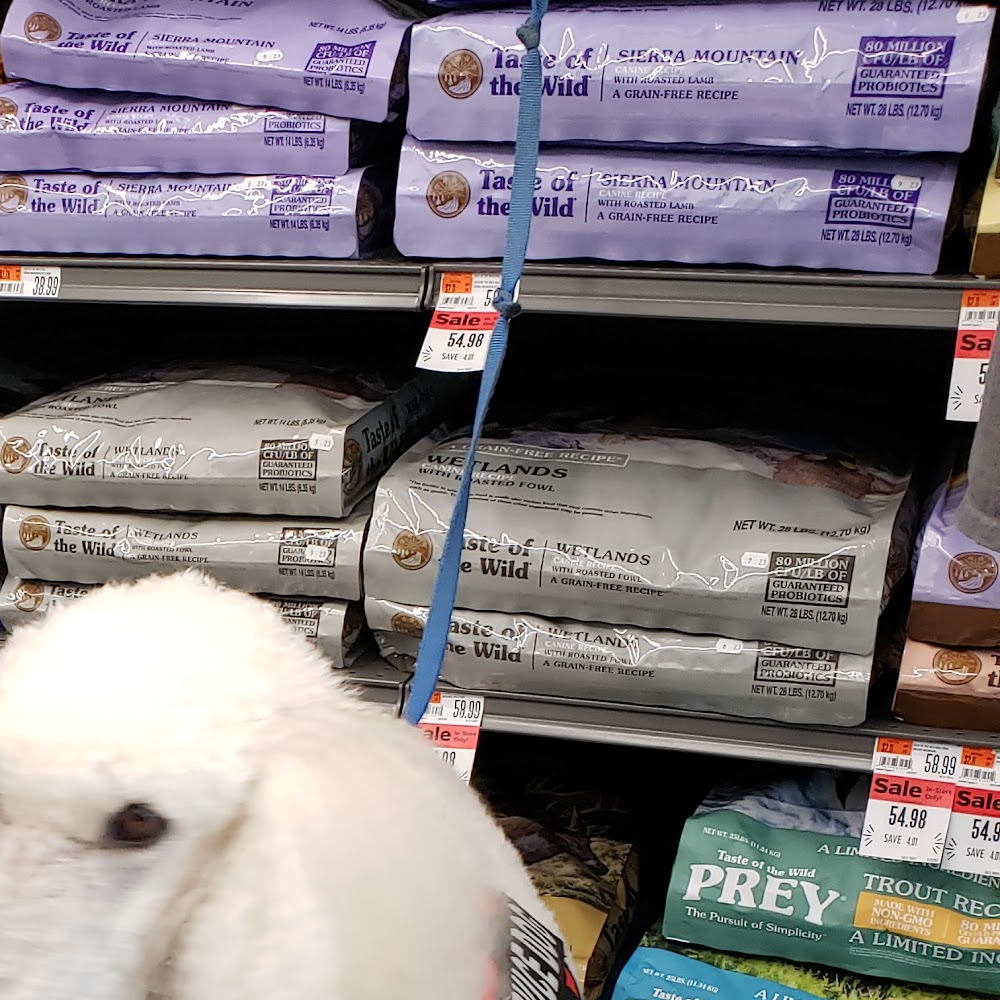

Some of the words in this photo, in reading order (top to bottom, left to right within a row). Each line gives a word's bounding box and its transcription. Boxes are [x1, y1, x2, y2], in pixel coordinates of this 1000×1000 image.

[116, 31, 138, 40] of
[91, 40, 131, 53] Wild
[203, 38, 275, 48] MOUNTAIN
[860, 68, 939, 80] GUARANTEED
[858, 81, 938, 93] PROBIOTICS
[625, 90, 693, 99] GRAIN-FREE
[697, 91, 738, 99] RECIPE
[74, 109, 95, 120] of
[846, 104, 861, 116] NET
[82, 181, 101, 195] of
[31, 198, 56, 213] the
[624, 200, 666, 209] ROASTED
[834, 200, 908, 213] GUARANTEED
[597, 212, 604, 220] A
[609, 212, 674, 223] GRAIN-FREE
[678, 215, 718, 224] RECIPE
[832, 211, 908, 224] PROBIOTICS
[435, 313, 481, 326] Sale
[447, 333, 484, 348] 54.98
[62, 461, 95, 476] Wild
[263, 461, 313, 469] GUARANTEED
[262, 469, 313, 477] PROBIOTICS
[54, 539, 77, 553] the
[82, 541, 116, 557] Wild
[775, 557, 792, 566] 80
[626, 585, 664, 597] RECIPE
[772, 581, 844, 592] GUARANTEED
[771, 591, 843, 603] PROBIOTICS
[761, 606, 774, 616] NET
[472, 641, 522, 663] Wild
[549, 660, 614, 674] GRAIN-FREE
[617, 667, 655, 678] RECIPE
[453, 700, 480, 718] 58.99
[925, 754, 957, 775] 58.99
[874, 778, 922, 798] Sale
[888, 805, 927, 829] 54.98
[884, 833, 902, 844] SAVE
[966, 848, 985, 858] SAVE
[718, 850, 749, 865] Taste
[752, 860, 765, 869] of
[766, 866, 785, 877] the
[788, 868, 816, 878] Wild
[863, 873, 948, 903] TROUT
[682, 864, 841, 926] PREY
[874, 899, 906, 910] MADE
[907, 905, 935, 917] WITH
[685, 906, 707, 919] The
[709, 912, 748, 927] Pursuit
[751, 922, 763, 930] of
[766, 923, 822, 941] Simplicity
[872, 907, 933, 928] NON-GMO
[849, 930, 865, 944] A
[872, 932, 963, 961] LIMITED
[754, 989, 767, 1000] A
